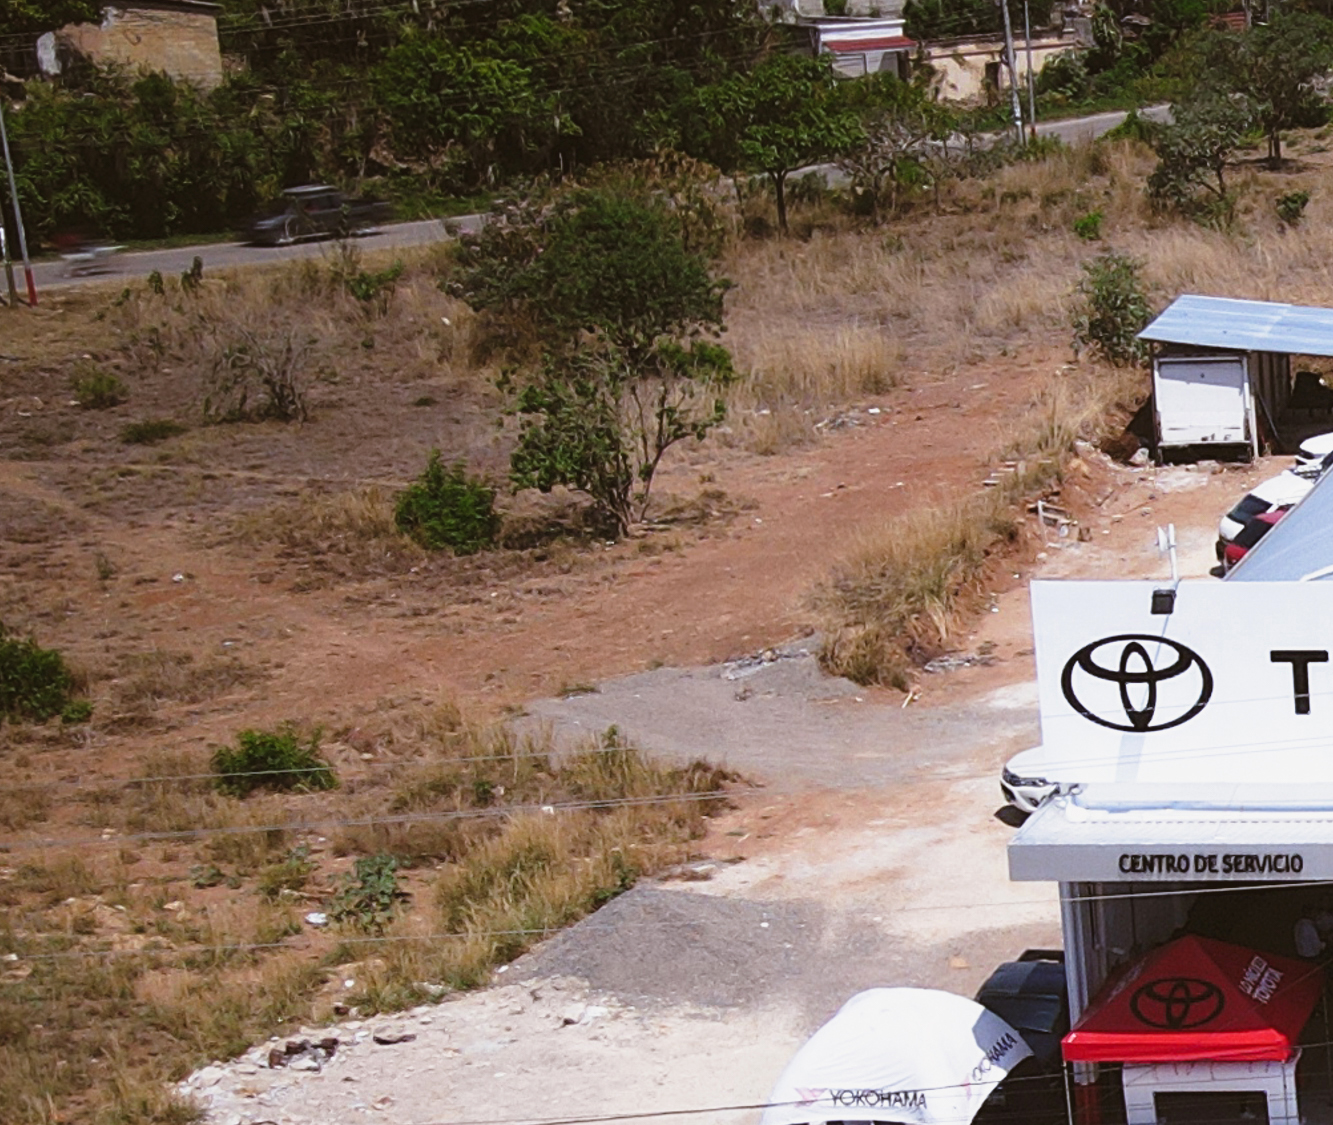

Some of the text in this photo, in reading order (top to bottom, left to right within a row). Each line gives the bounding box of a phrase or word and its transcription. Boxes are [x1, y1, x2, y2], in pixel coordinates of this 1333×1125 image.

[1118, 854, 1304, 873] CENTRO DE SERVICIO
[1252, 967, 1284, 1004] TOYOTA
[830, 1089, 927, 1109] YOKOHAMA
